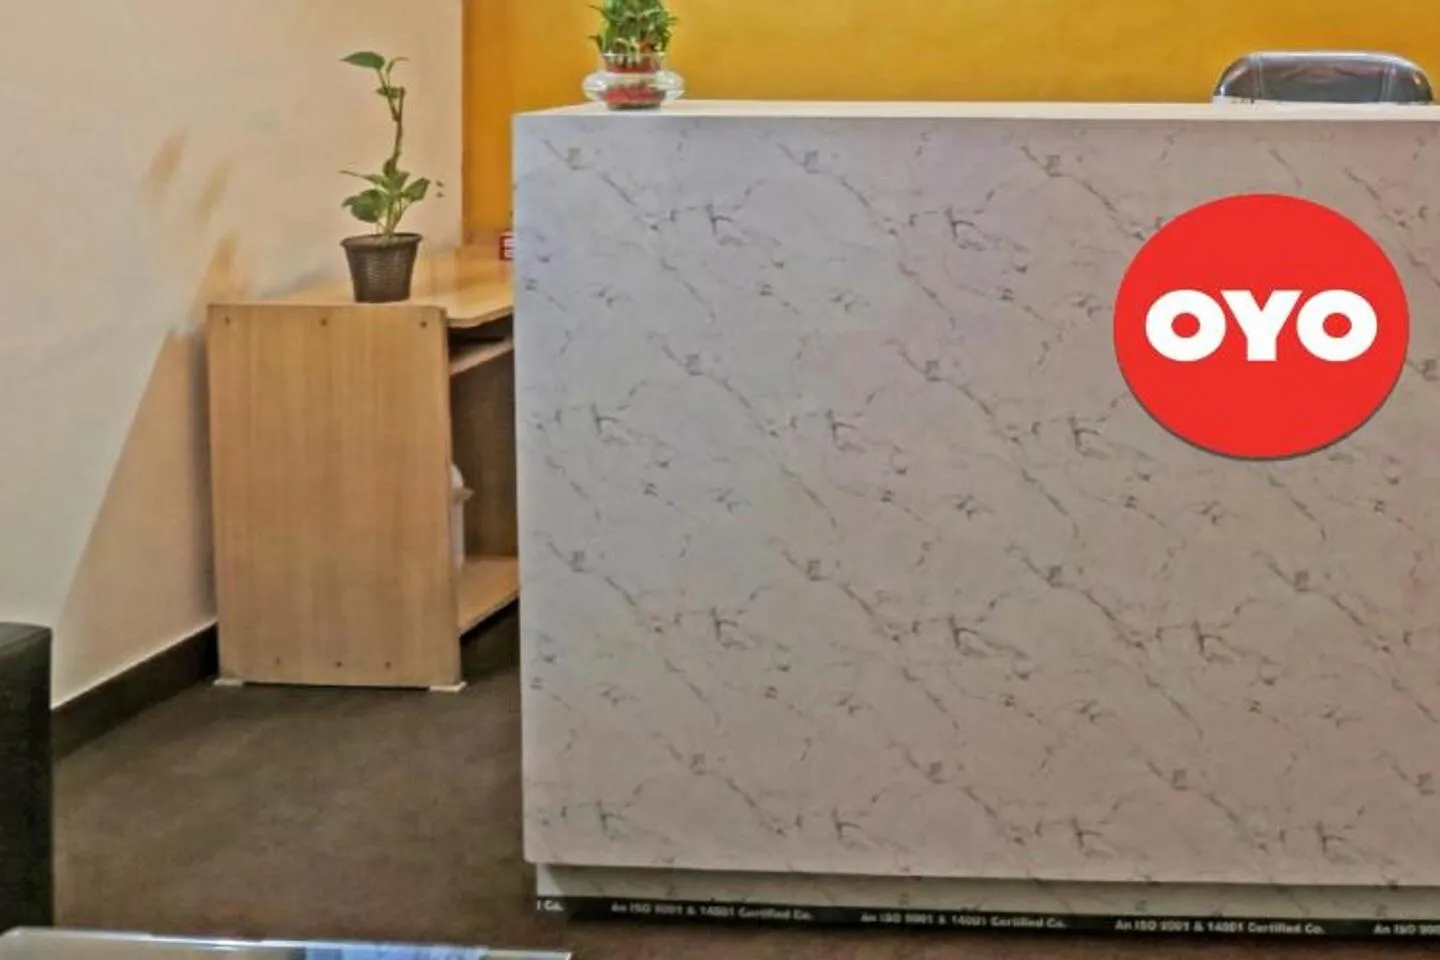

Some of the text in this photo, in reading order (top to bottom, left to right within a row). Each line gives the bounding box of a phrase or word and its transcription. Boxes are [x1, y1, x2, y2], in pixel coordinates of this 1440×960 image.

[1145, 289, 1378, 362] OYO
[1134, 920, 1157, 931] ISO
[1247, 922, 1301, 933] Certified
[1392, 924, 1416, 935] ISO
